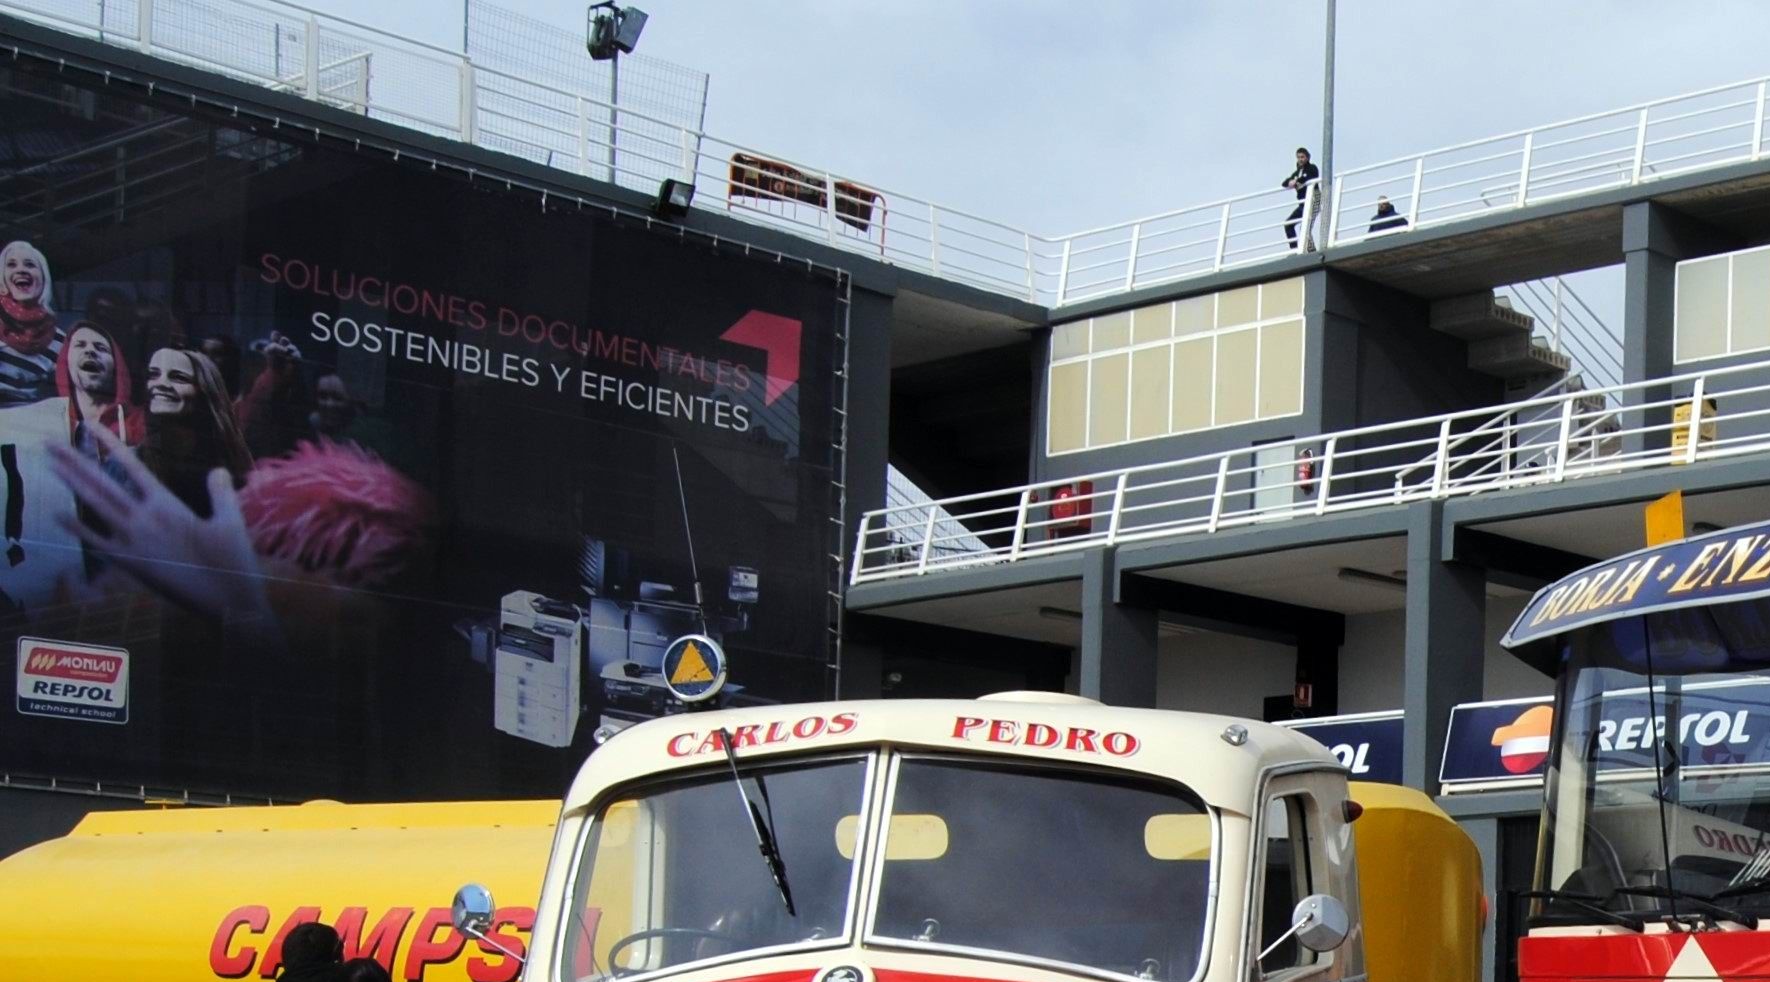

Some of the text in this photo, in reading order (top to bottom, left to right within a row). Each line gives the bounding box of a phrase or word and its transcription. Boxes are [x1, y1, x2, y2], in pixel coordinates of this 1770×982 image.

[260, 253, 750, 392] SOLUCIONES DOCUMENTALES
[310, 311, 750, 433] SOSTENIBLES Y EFICIENTES
[1529, 555, 1662, 628] BORJA
[57, 655, 116, 673] MONLAU
[30, 702, 117, 719] technical school
[33, 680, 114, 702] REPSOL
[666, 711, 1143, 759] CARLOS PEDRO
